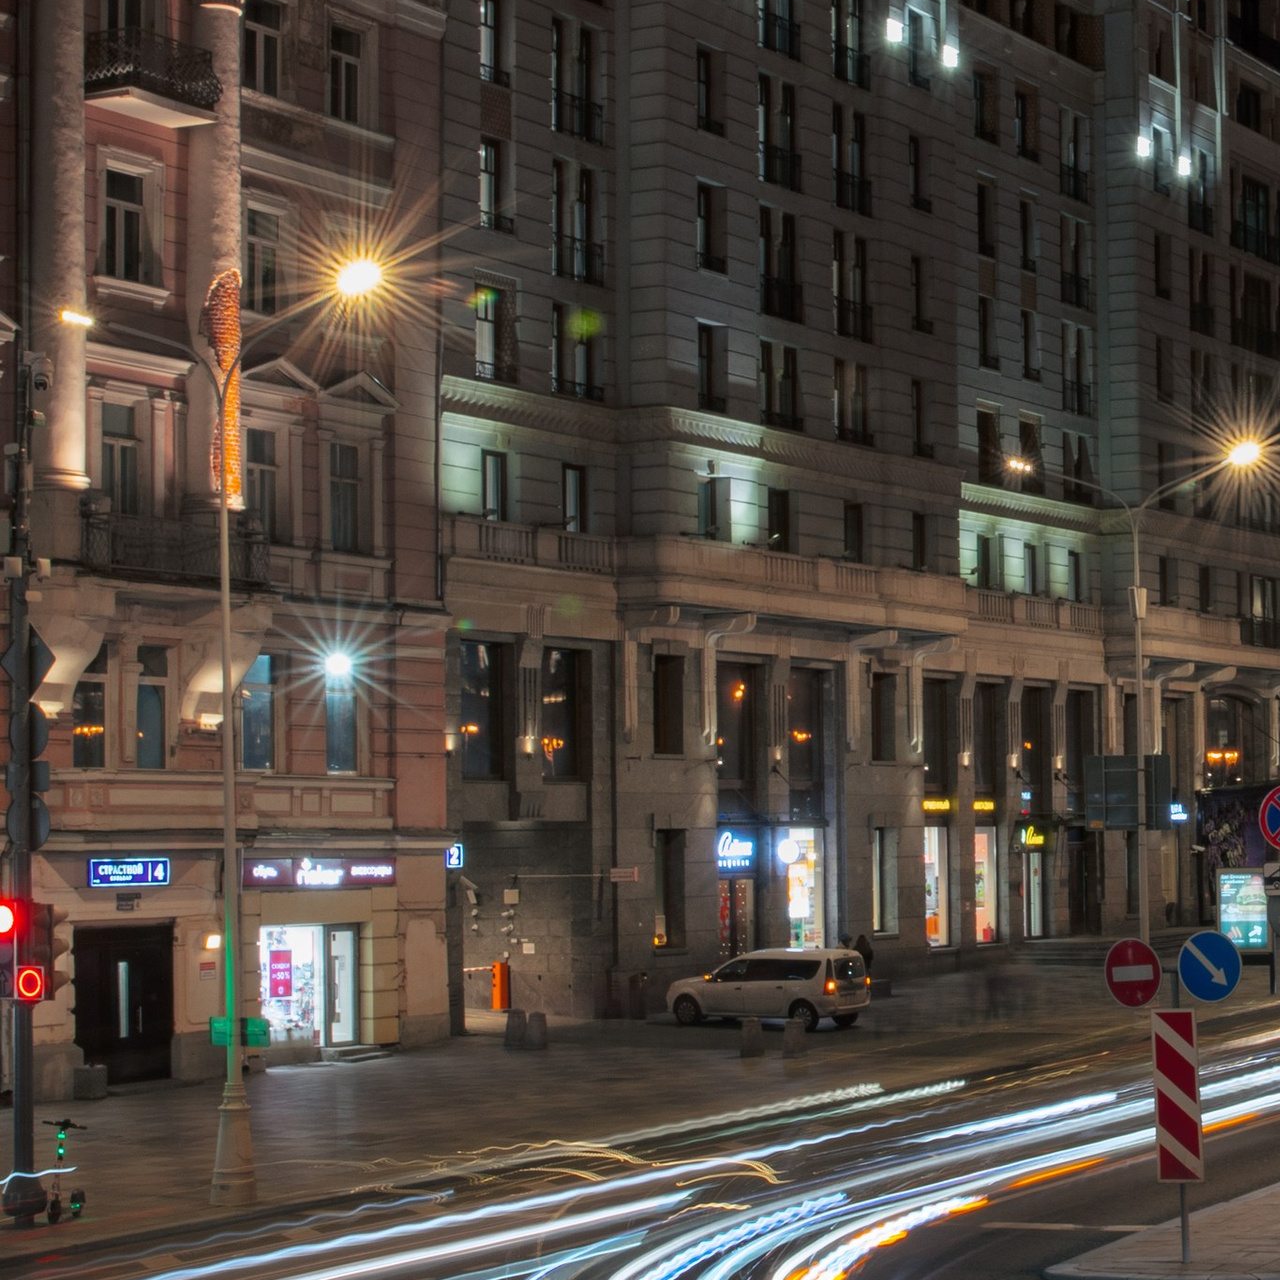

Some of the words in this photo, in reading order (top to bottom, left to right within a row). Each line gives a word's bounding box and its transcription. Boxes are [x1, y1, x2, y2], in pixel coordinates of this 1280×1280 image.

[450, 846, 460, 865] 2
[98, 862, 144, 875] СТРАСТНОЙ
[153, 863, 165, 880] 4
